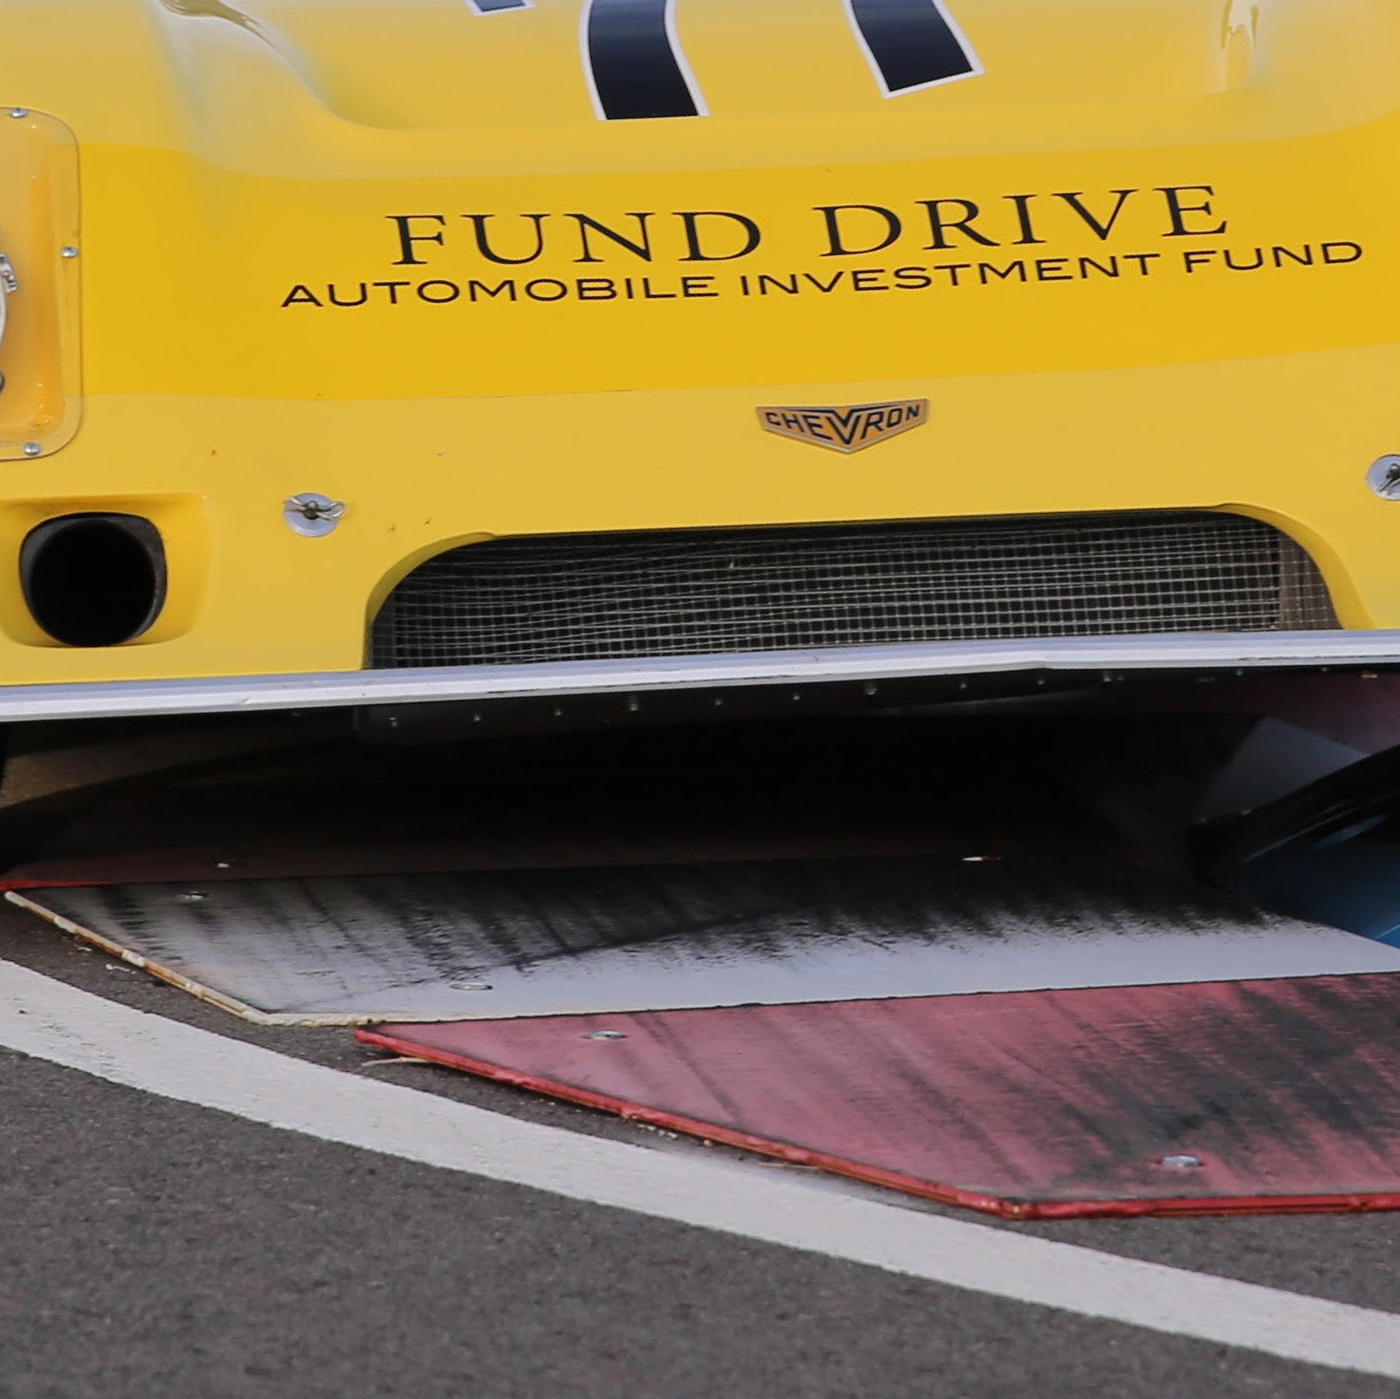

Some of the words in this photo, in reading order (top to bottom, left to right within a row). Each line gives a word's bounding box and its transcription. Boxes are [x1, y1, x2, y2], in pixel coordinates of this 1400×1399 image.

[385, 210, 762, 266] FUND
[811, 185, 1228, 257] DRIVE
[280, 275, 719, 308] AUTOMOBILE
[741, 253, 1161, 297] INVESTMENT
[1183, 241, 1363, 274] FUND
[764, 404, 921, 445] CHEVRON
